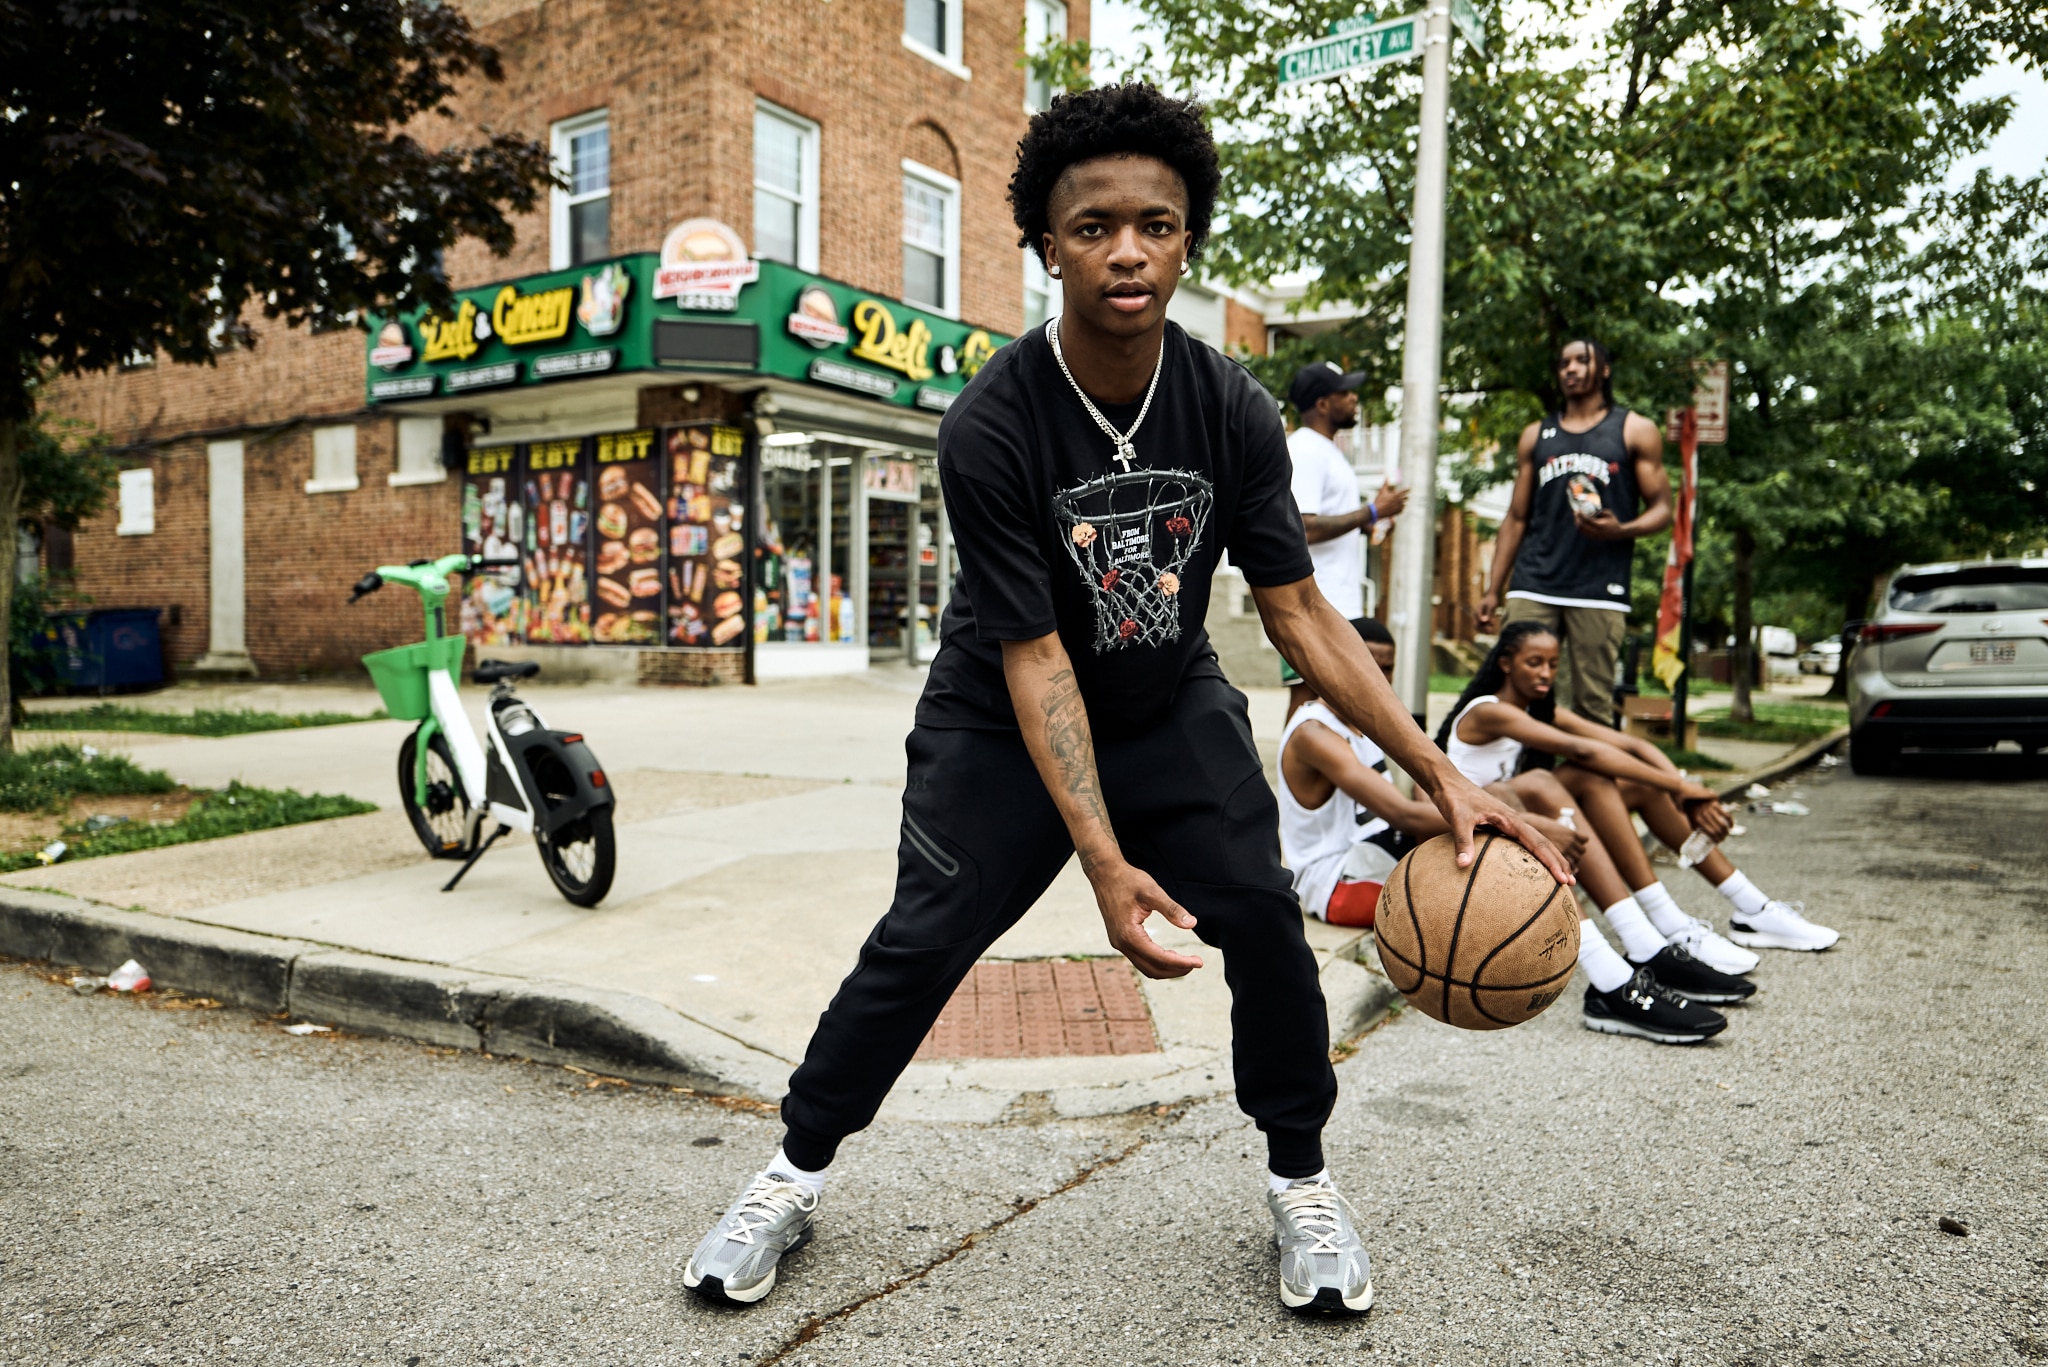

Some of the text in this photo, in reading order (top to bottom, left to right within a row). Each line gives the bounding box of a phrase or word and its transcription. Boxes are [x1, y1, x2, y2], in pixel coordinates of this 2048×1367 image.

[1285, 29, 1411, 79] CHAUNCEY AV.
[493, 286, 573, 345] Grocery
[852, 300, 934, 381] Deli
[530, 446, 579, 470] EBT
[597, 435, 653, 462] EBT
[468, 451, 512, 475] EBT
[1111, 534, 1150, 550] BALTIMORE
[1121, 527, 1140, 539] FROM
[1114, 551, 1150, 566] BALTIMORE
[1123, 546, 1138, 555] FOR
